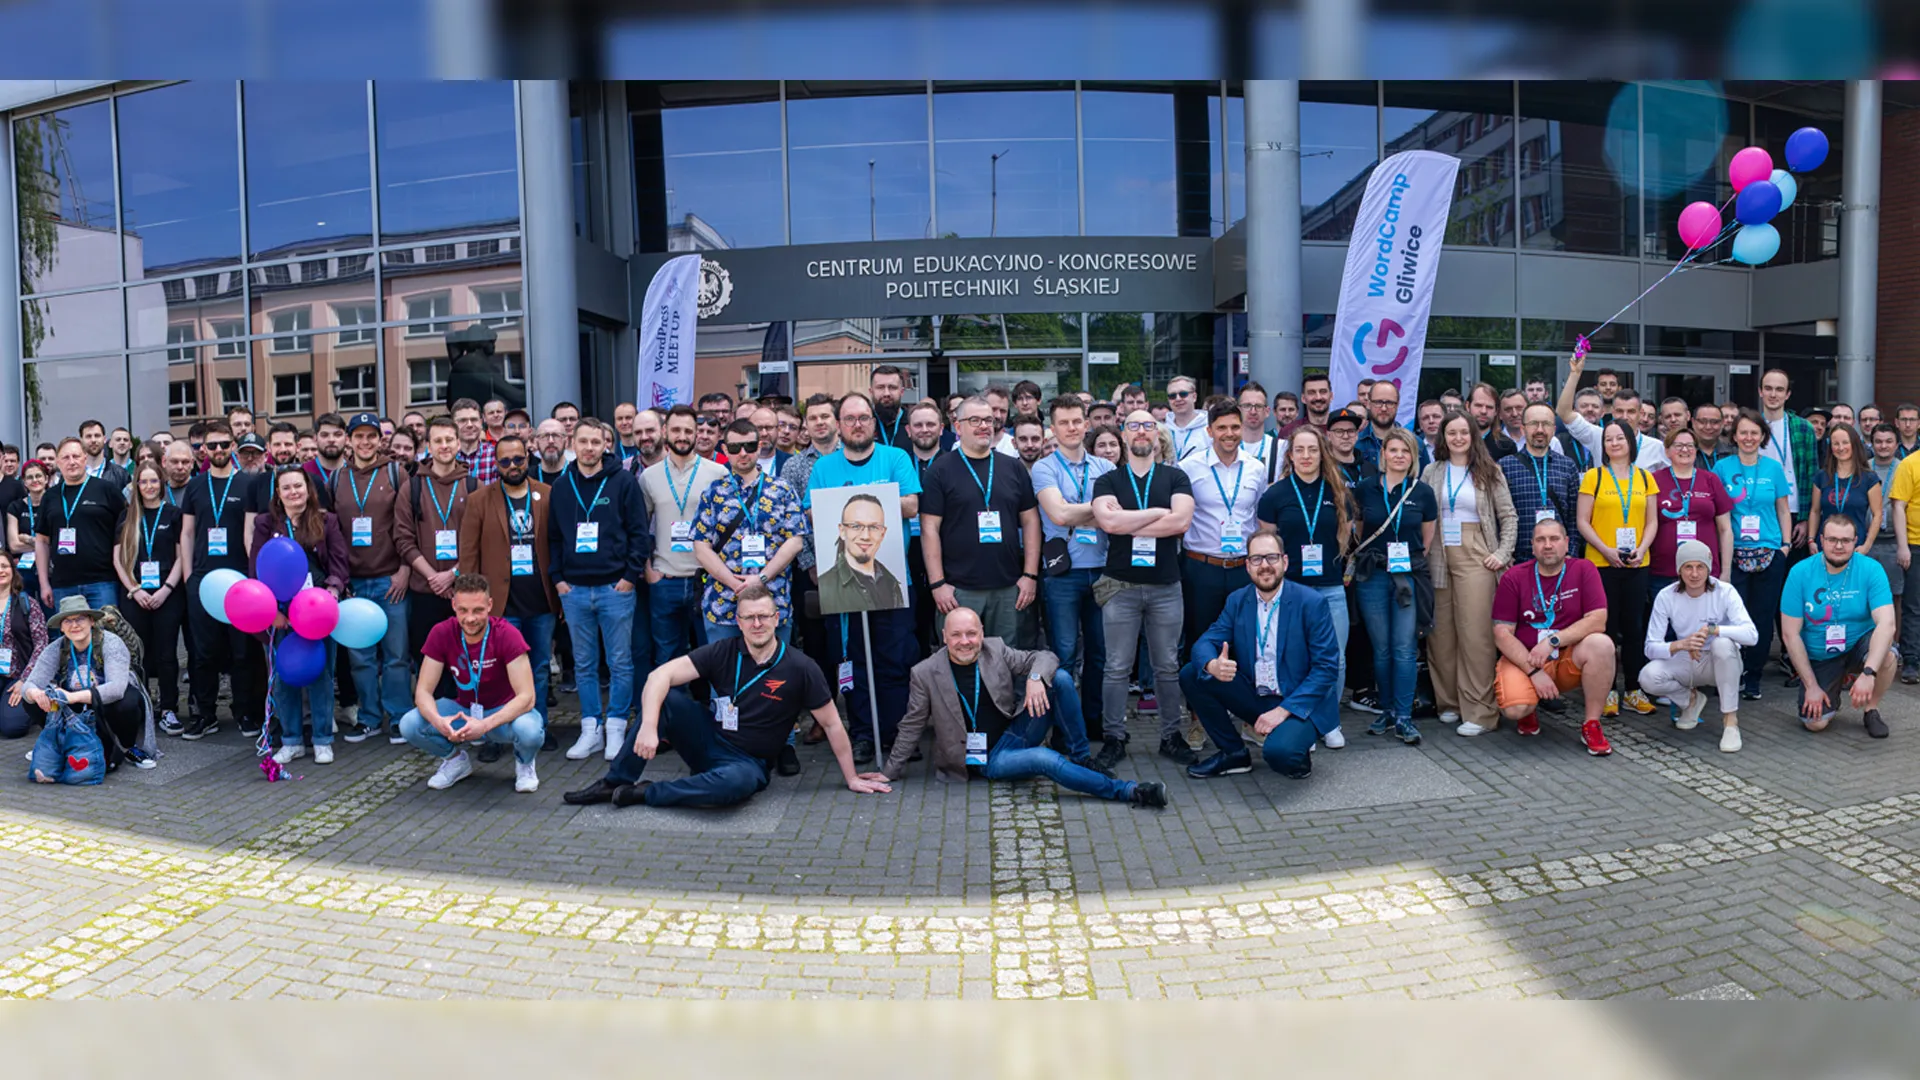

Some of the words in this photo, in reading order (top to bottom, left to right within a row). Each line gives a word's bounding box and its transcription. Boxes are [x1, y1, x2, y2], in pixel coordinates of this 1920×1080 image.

[806, 257, 903, 278] CENTRUM
[1367, 173, 1411, 298] WordCamp
[1396, 225, 1423, 304] Gliwice
[886, 278, 1019, 299] POLITECHNIKI
[1033, 275, 1120, 298] ŚLĄSKIEJ
[654, 305, 669, 373] WordPress
[667, 310, 681, 375] MEETUP
